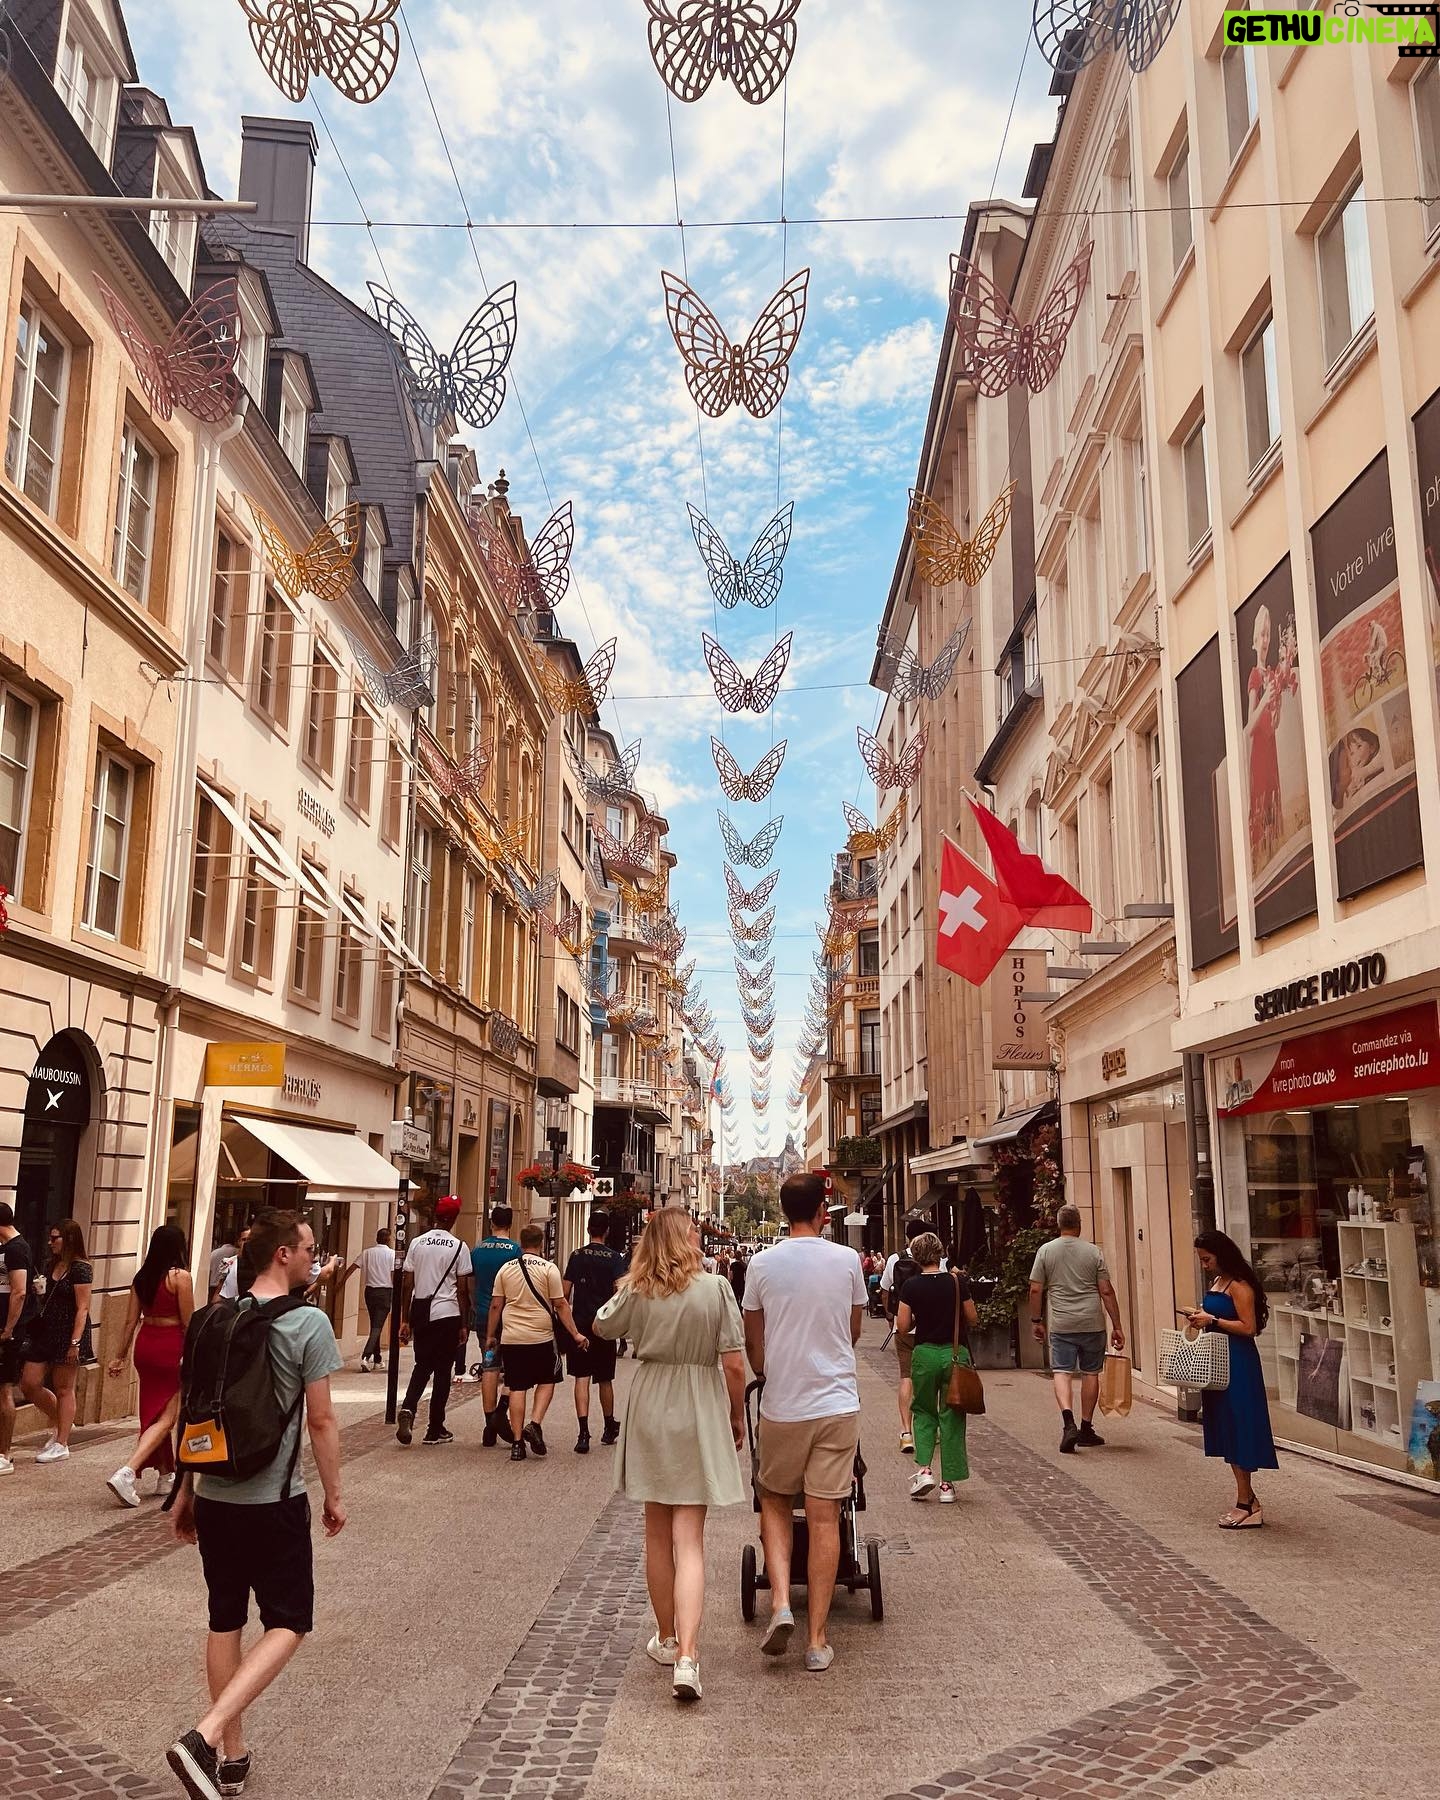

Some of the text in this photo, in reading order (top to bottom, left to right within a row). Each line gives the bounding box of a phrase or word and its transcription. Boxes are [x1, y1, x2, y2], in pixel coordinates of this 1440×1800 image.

[1330, 526, 1394, 597] Votre livre
[1254, 953, 1385, 1021] SERVICE PHOTO
[996, 1043, 1044, 1060] Fleurs
[1352, 1030, 1412, 1054] Commandez via
[1280, 1058, 1295, 1070] mon
[1353, 1049, 1429, 1078] servicephoto.lu
[32, 1066, 81, 1086] MAUBOUSSIN
[1272, 1068, 1336, 1093] livre photo cewe
[426, 1237, 454, 1248] SAGRES
[495, 1242, 514, 1250] BOCK
[527, 1259, 546, 1267] BOCK
